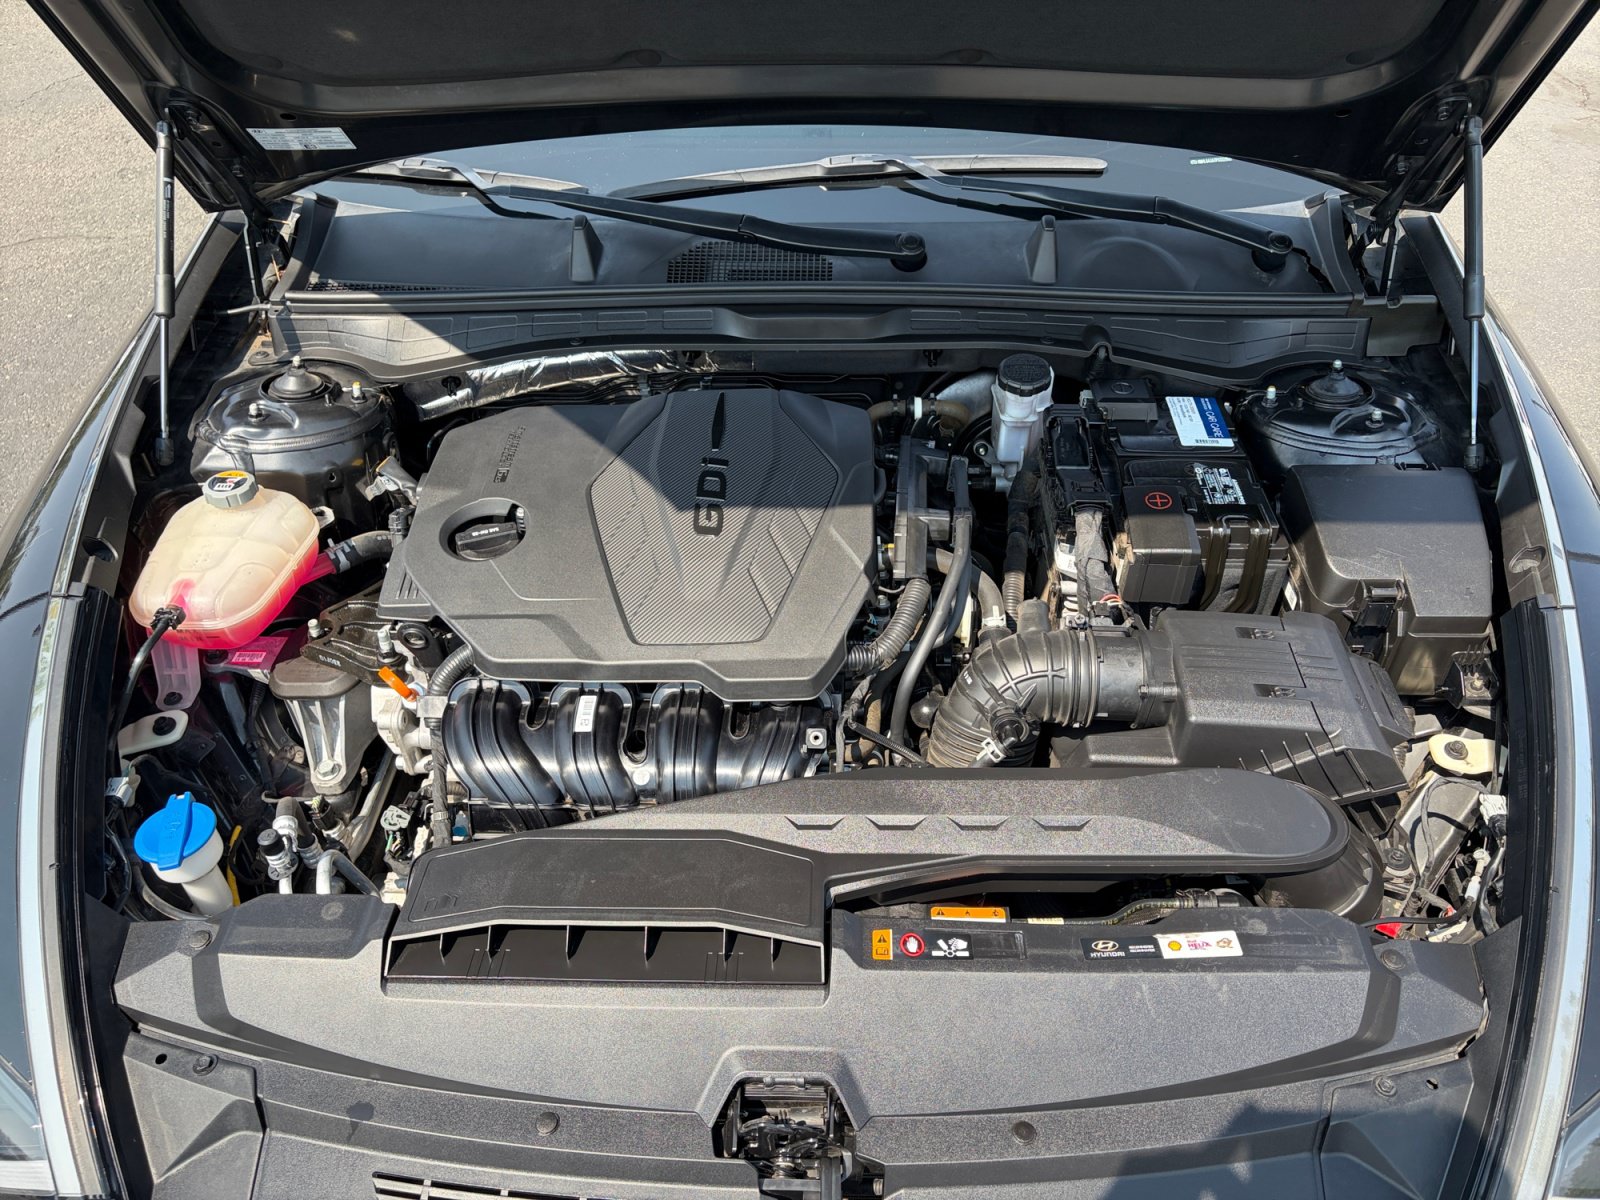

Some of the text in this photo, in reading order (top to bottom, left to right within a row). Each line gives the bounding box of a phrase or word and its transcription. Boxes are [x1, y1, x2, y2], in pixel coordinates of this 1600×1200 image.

[1205, 411, 1217, 422] CAR
[1210, 423, 1225, 438] CARE
[693, 457, 729, 537] GDi
